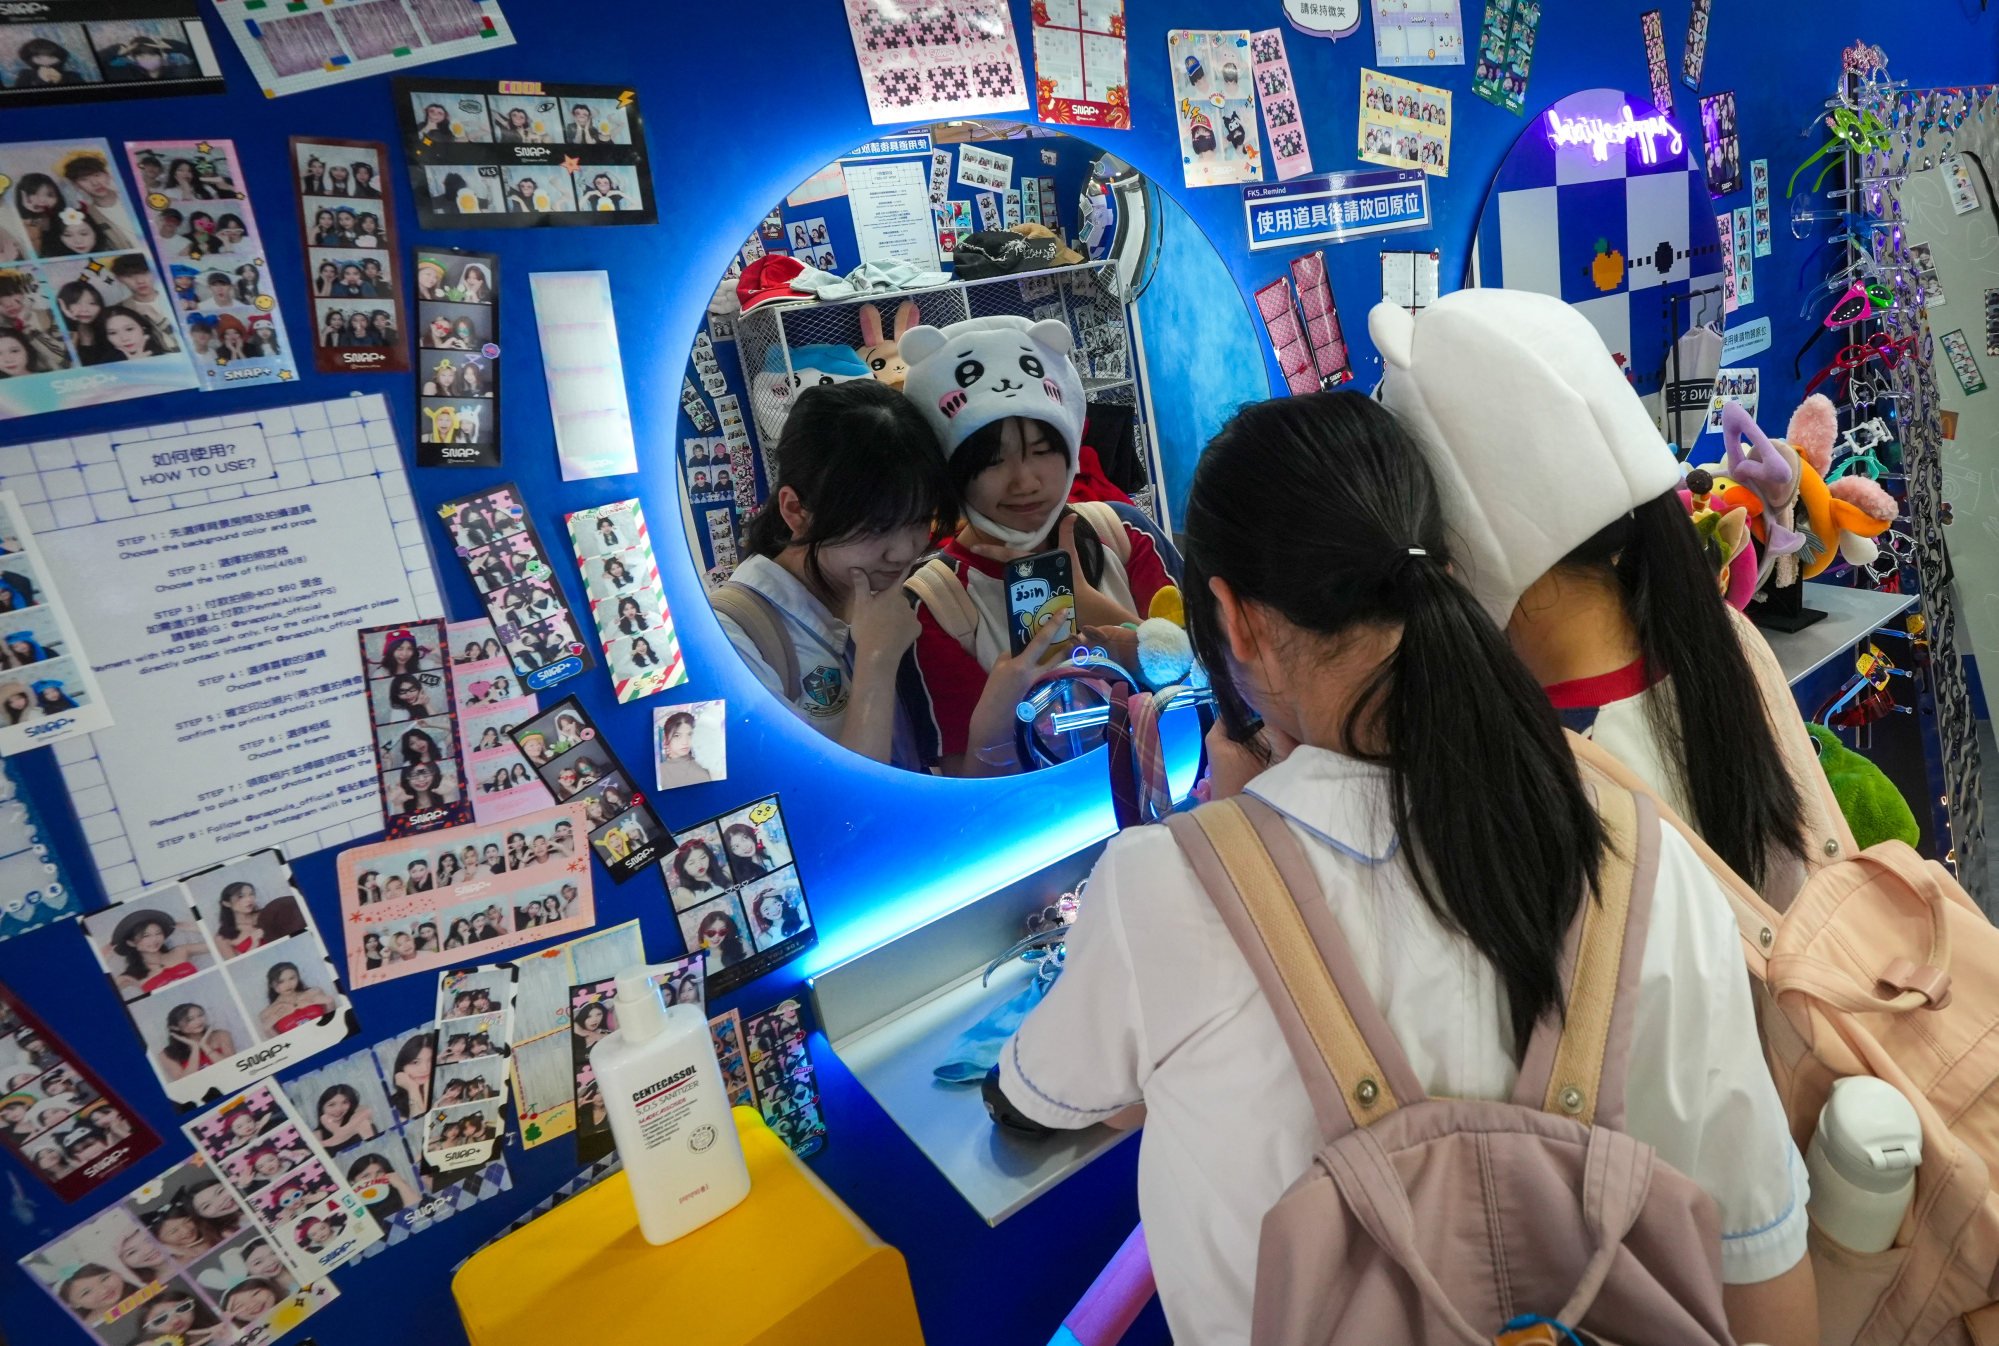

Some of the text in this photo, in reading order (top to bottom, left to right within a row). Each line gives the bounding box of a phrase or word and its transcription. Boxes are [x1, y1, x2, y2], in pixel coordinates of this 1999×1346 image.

[1301, 3, 1346, 18] 請保持微笑
[1072, 105, 1099, 115] SNAP+
[514, 147, 551, 157] SNAP+
[1257, 192, 1420, 236] 使用道具後請放回原位
[343, 353, 386, 363] SNAP+
[224, 367, 271, 382] SNAP+
[152, 444, 236, 467] 如何使用?
[442, 449, 480, 458] SNAP+
[140, 458, 256, 486] HOW TO USE?
[117, 536, 146, 547] STEP
[119, 517, 318, 560] Choose the background color and props
[155, 580, 194, 592] Choose
[197, 575, 213, 585] the
[216, 571, 238, 581] type
[240, 566, 251, 576] of
[168, 566, 196, 577] STEP
[154, 608, 182, 620] STEP
[91, 659, 132, 672] ayment
[135, 652, 158, 662] with
[161, 645, 186, 656] HKD
[212, 635, 235, 645] cash
[264, 625, 279, 633] For
[284, 620, 298, 628] the
[301, 613, 330, 625] online
[332, 603, 368, 618] payment
[371, 597, 399, 609] please
[139, 661, 179, 675] directly
[182, 651, 220, 665] contact
[535, 662, 569, 681] SNAP+
[198, 674, 225, 687] STEP
[226, 667, 307, 692] Choose the filter
[24, 718, 75, 737] SNAP+
[175, 717, 202, 730] STEP
[177, 728, 217, 742] confirm
[219, 723, 235, 731] the
[238, 712, 276, 727] printing
[319, 695, 338, 705] time
[239, 739, 265, 751] STEP
[248, 735, 330, 761] Choose the frame
[149, 808, 200, 828] Remember
[204, 804, 216, 812] to
[218, 796, 239, 810] pick
[242, 793, 255, 801] up
[257, 786, 278, 798] your
[281, 776, 313, 791] photos
[316, 769, 332, 780] and
[357, 758, 372, 768] the
[198, 788, 224, 801] STEP
[215, 829, 250, 844] Follow
[254, 823, 268, 832] our
[320, 801, 339, 812] will
[341, 797, 352, 805] be
[409, 810, 448, 826] SNAP+
[156, 835, 186, 849] STEP
[206, 818, 242, 834] Follow
[625, 847, 655, 870] SNAP+
[236, 1042, 291, 1073] SNAP+
[632, 1065, 697, 1102] CENTECASSOL
[658, 1080, 699, 1103] SANITIZER
[84, 1147, 130, 1178] SNAP+
[445, 1148, 481, 1162] SNAP+
[404, 1195, 453, 1225] SNAP+
[319, 1239, 356, 1266] SNAP+
